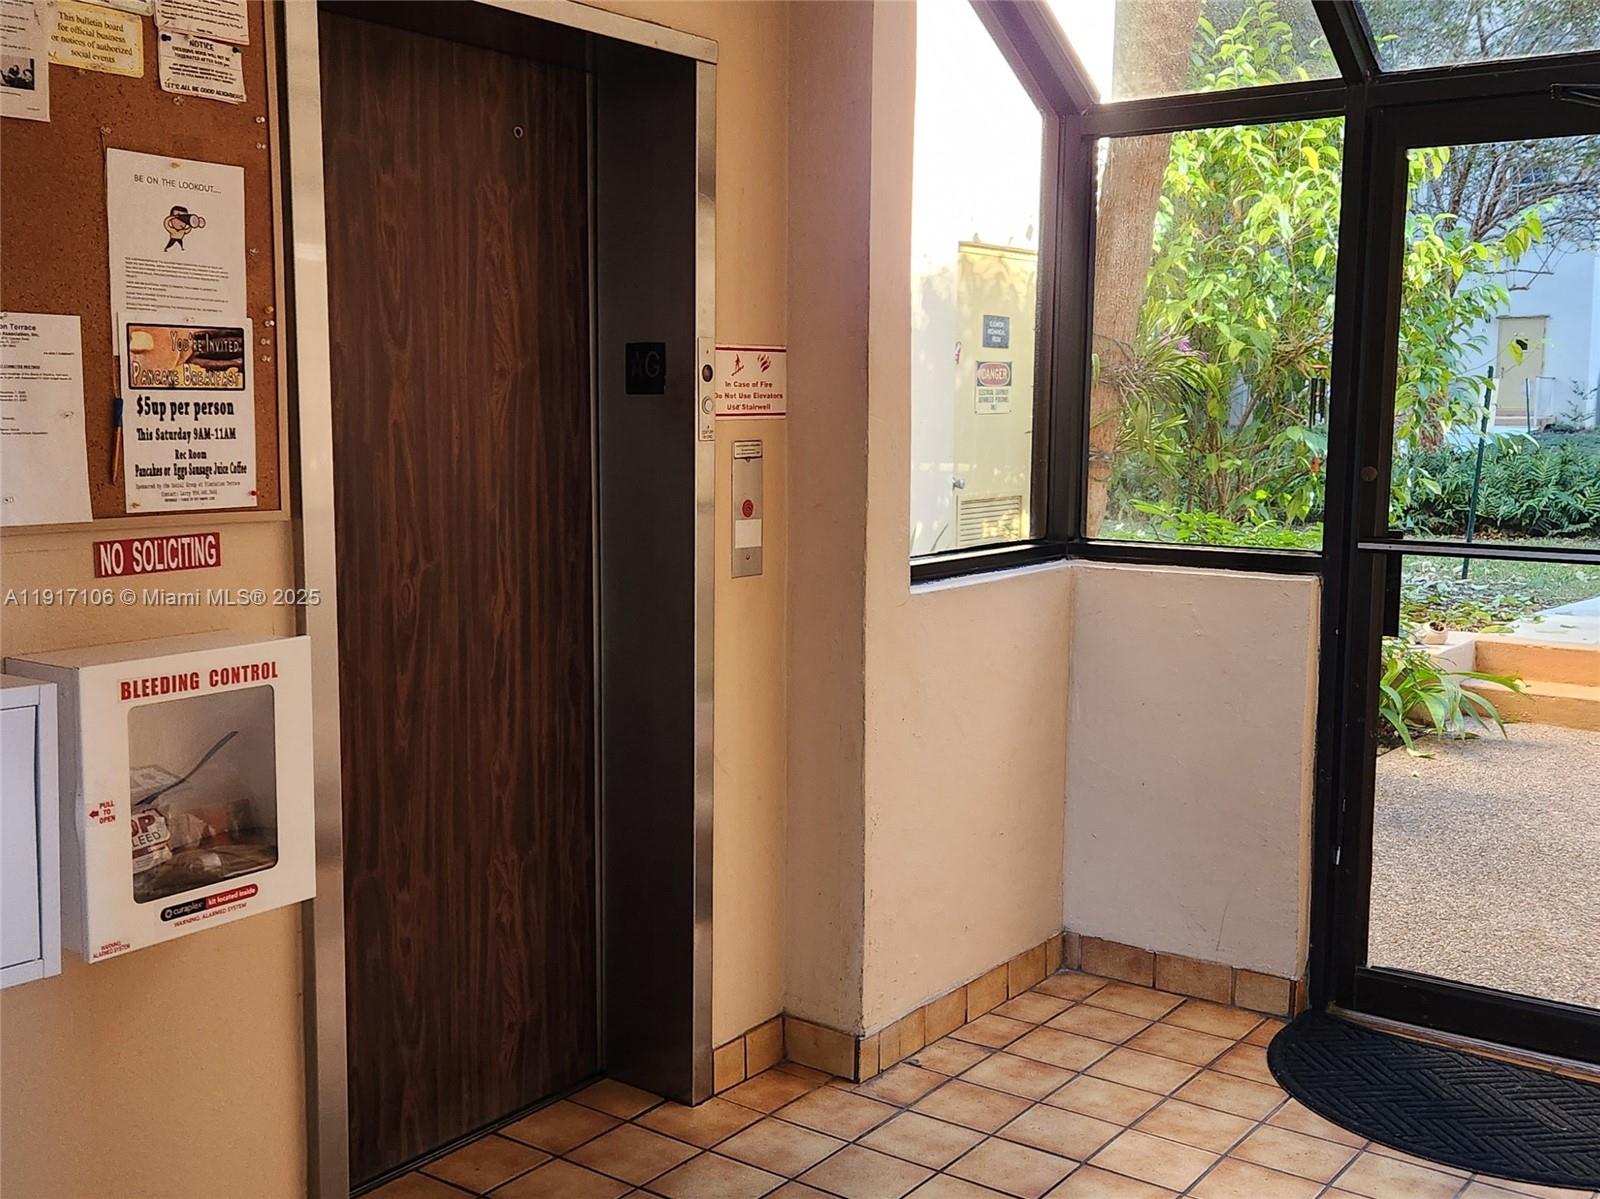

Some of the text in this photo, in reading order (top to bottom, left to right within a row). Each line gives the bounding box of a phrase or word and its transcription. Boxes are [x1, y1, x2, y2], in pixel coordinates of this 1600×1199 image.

[58, 11, 125, 32] This bulletin board
[57, 23, 126, 43] for official business
[60, 36, 86, 47] notices
[87, 41, 95, 49] of
[96, 43, 133, 56] authorized
[189, 40, 215, 51] NOTICE
[71, 50, 116, 63] social events
[134, 174, 144, 183] BE
[146, 176, 159, 185] ON
[162, 178, 176, 188] THE
[9, 323, 36, 331] Terrace
[981, 368, 1008, 380] DANGER
[136, 394, 234, 421] $5up per person
[136, 427, 236, 444] This Saturday 9AM-11AM
[175, 449, 207, 460] Rec Room
[135, 461, 247, 480] Pancakes or Eggs Sausage Juice Coffee
[100, 535, 216, 576] NO SOLICITING
[120, 661, 278, 701] BLEEDING CONTROL
[99, 800, 114, 810] PULL
[99, 815, 116, 824] OPEN
[172, 887, 256, 915] curaplex kit located inside
[202, 908, 227, 920] ALARMED
[228, 903, 248, 913] SYSTEM
[93, 943, 131, 959] ALARMED SYSTEM
